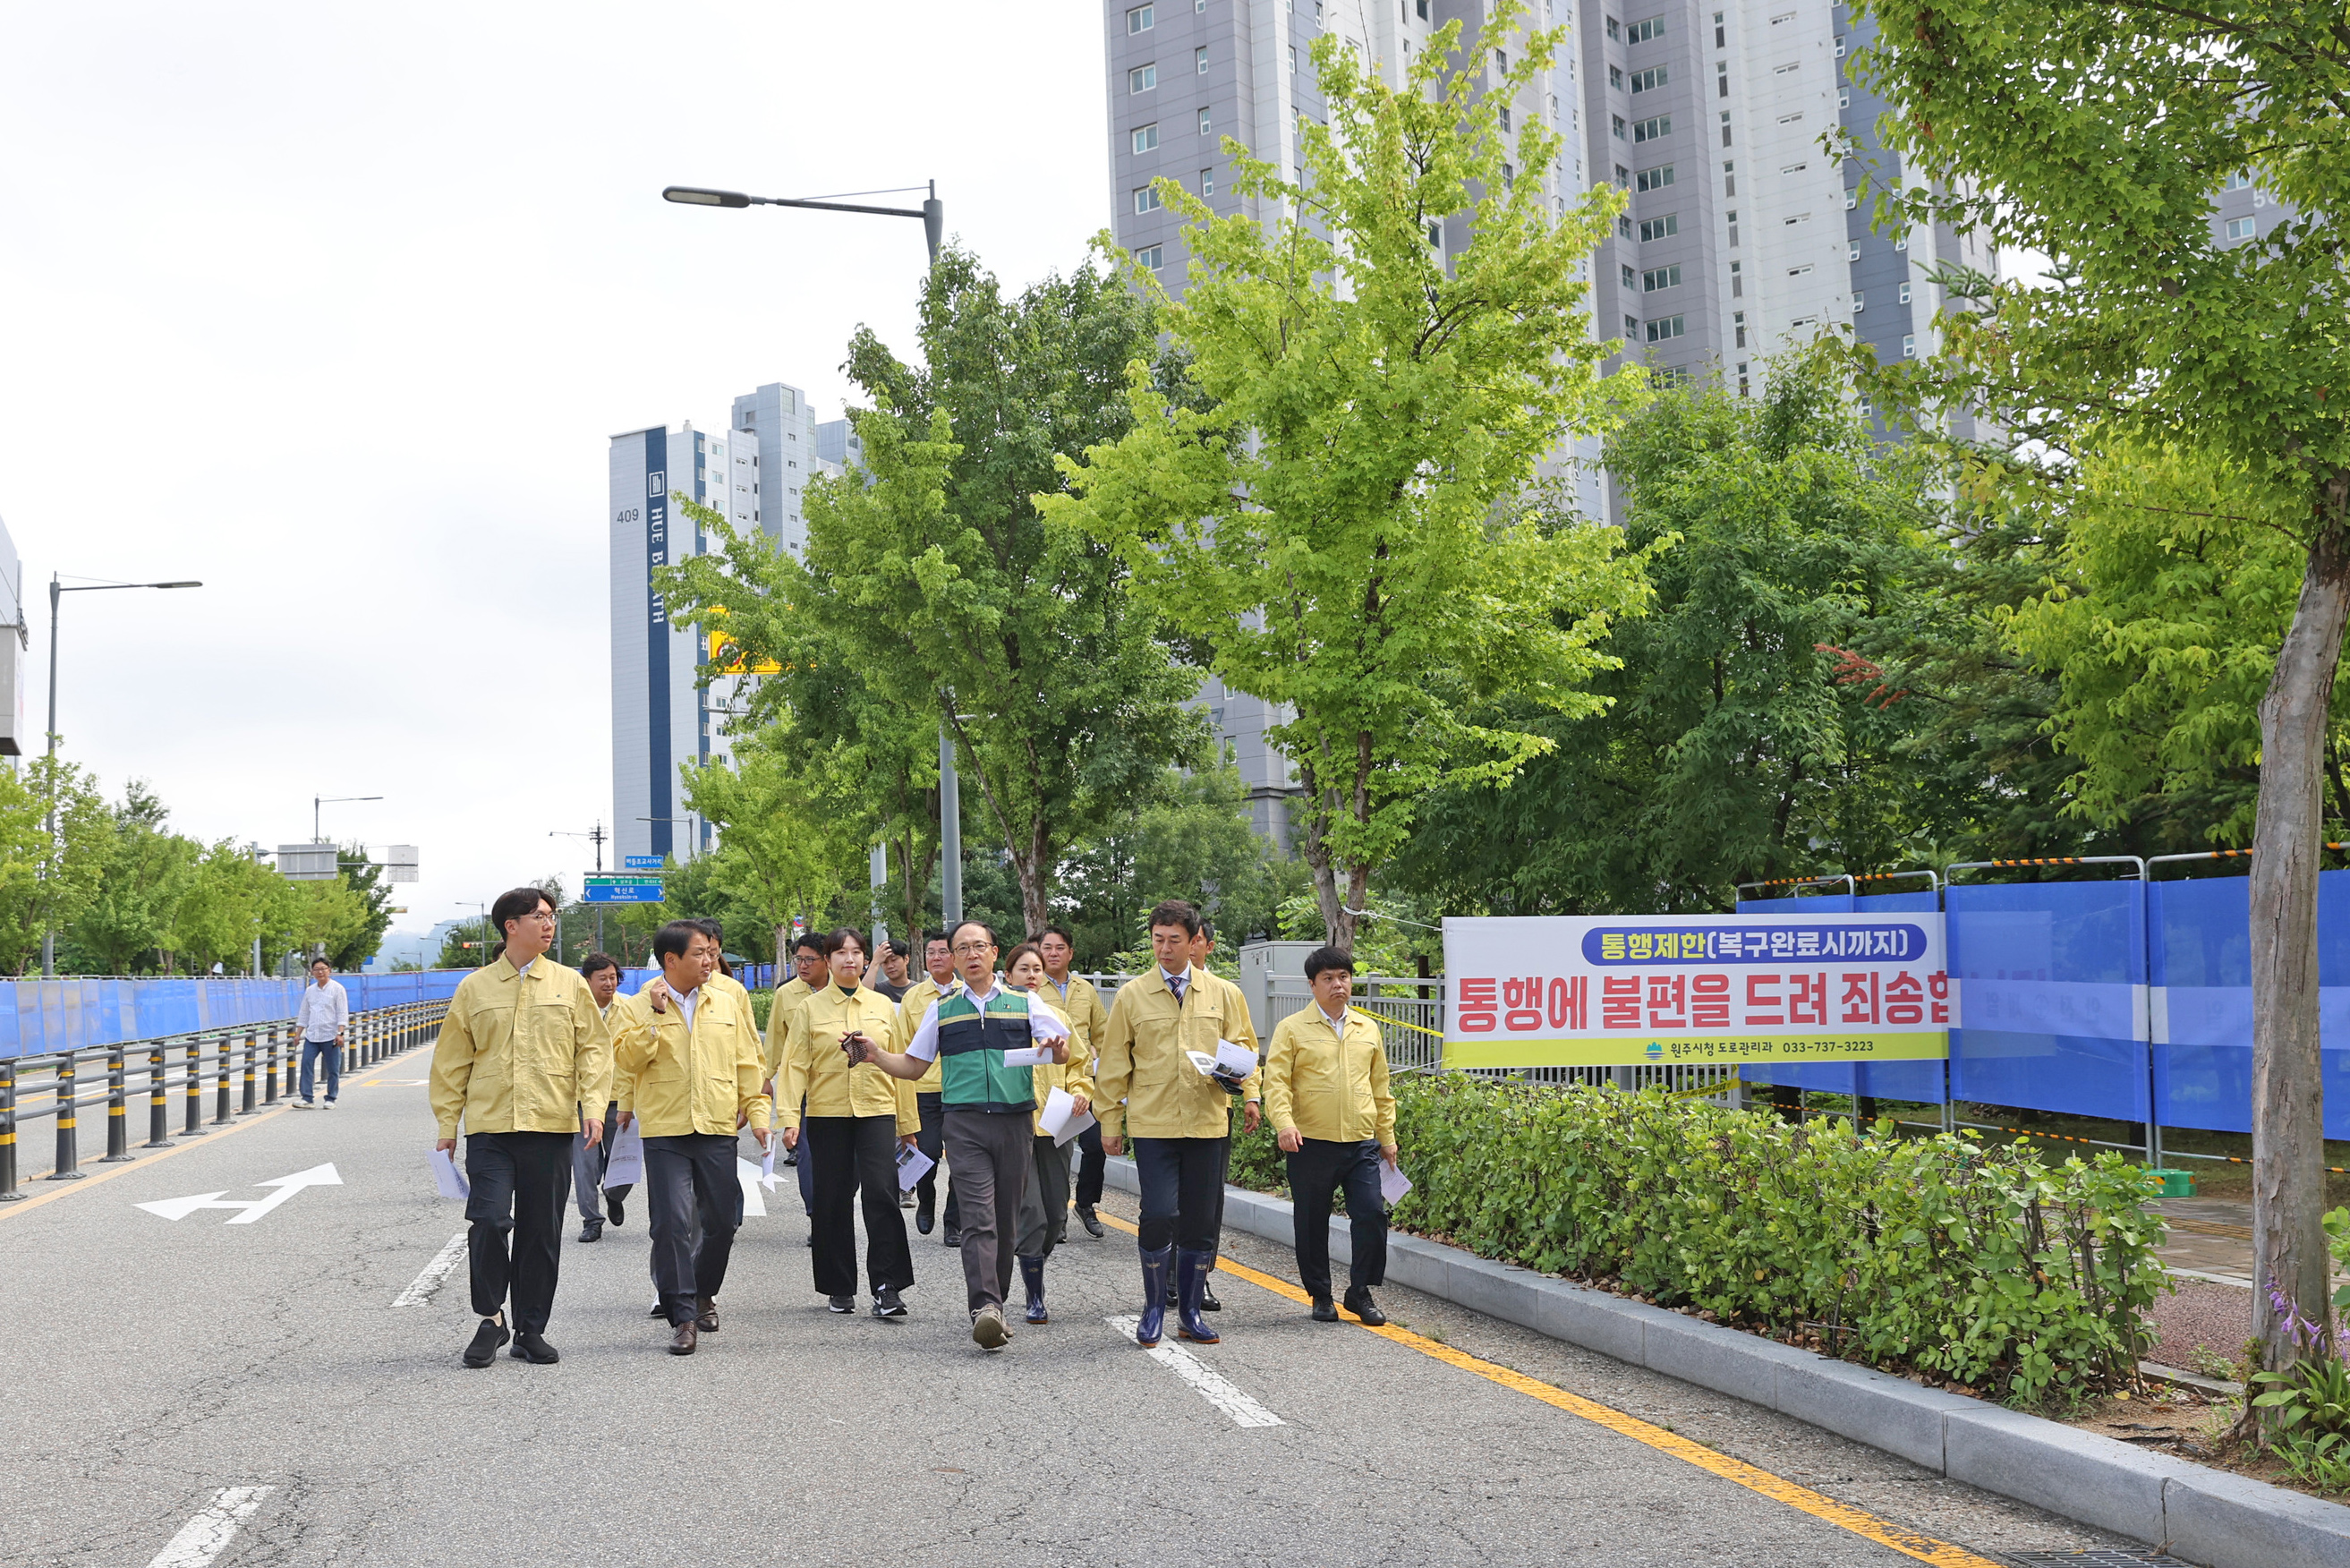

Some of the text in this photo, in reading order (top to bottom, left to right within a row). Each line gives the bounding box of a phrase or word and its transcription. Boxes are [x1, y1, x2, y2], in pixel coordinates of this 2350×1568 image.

[617, 507, 639, 524] 409
[651, 506, 664, 624] HUE BATH
[1601, 929, 1909, 960] 통행제한(복구완료시까지)
[1458, 976, 1588, 1033] 통행에
[1602, 974, 1731, 1029] 불편을
[1745, 972, 1827, 1026] 드려
[1670, 1041, 1874, 1058] 원주시청 도로관리과 033-737-3223
